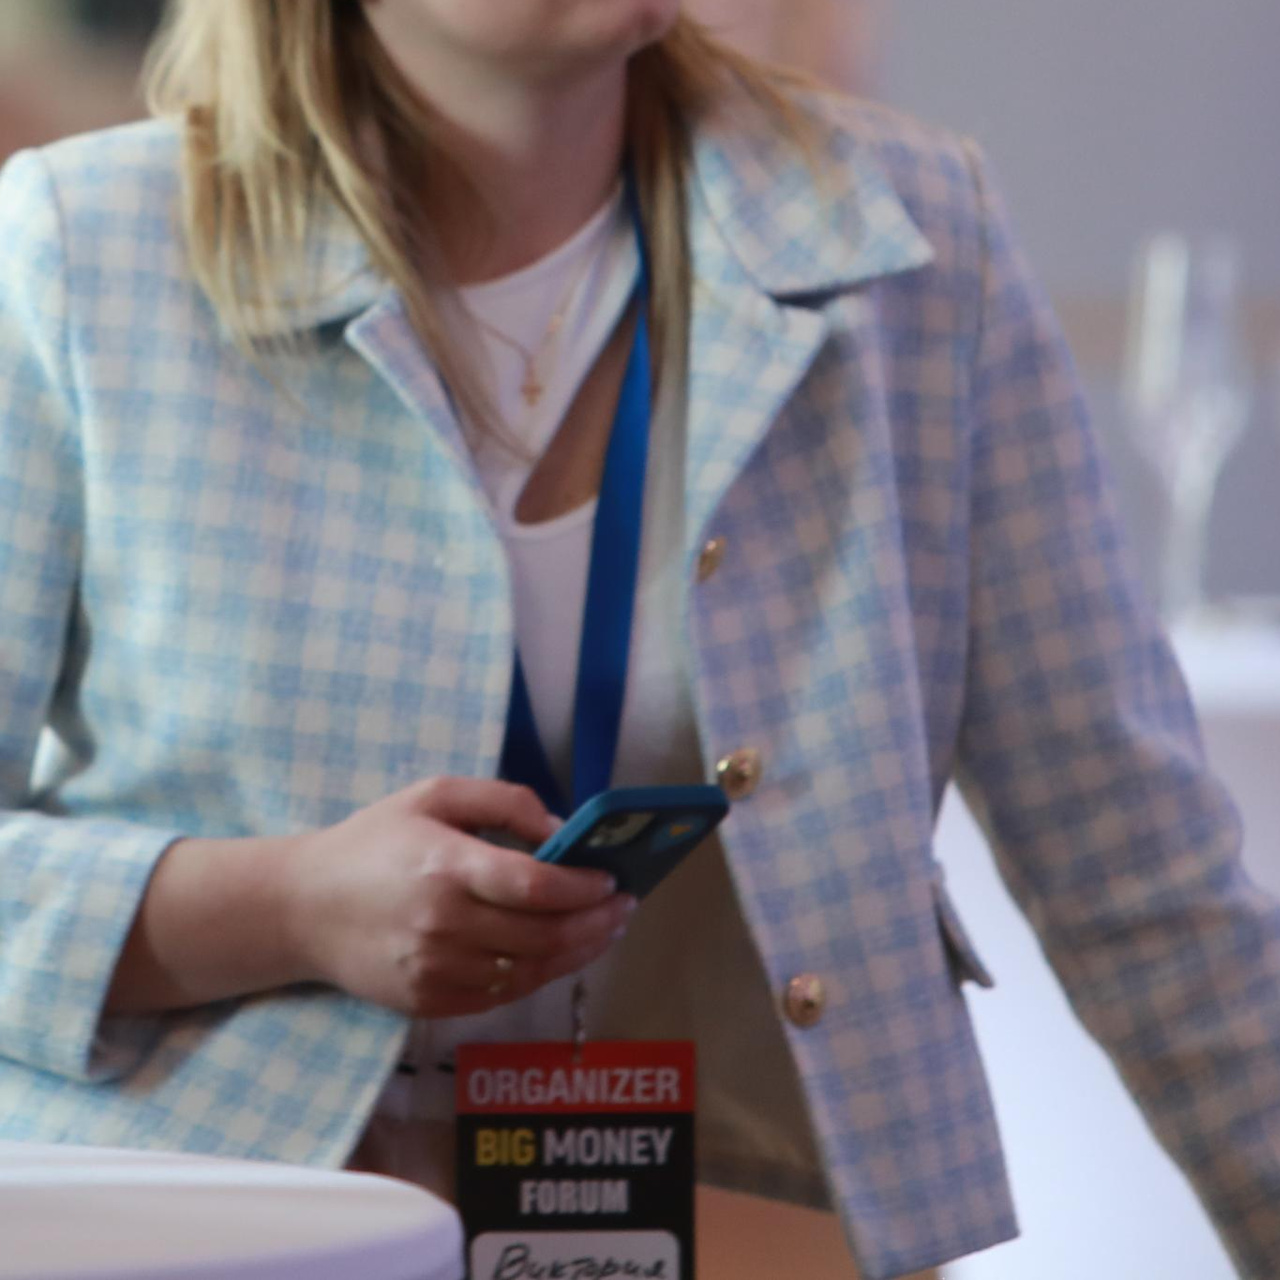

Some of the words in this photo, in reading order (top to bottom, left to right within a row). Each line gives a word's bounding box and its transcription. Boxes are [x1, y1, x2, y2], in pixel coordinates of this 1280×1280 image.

[470, 1067, 681, 1106] ORGANIZER
[476, 1128, 536, 1166] BIG
[543, 1127, 673, 1166] MONEY
[520, 1179, 629, 1215] FORUM
